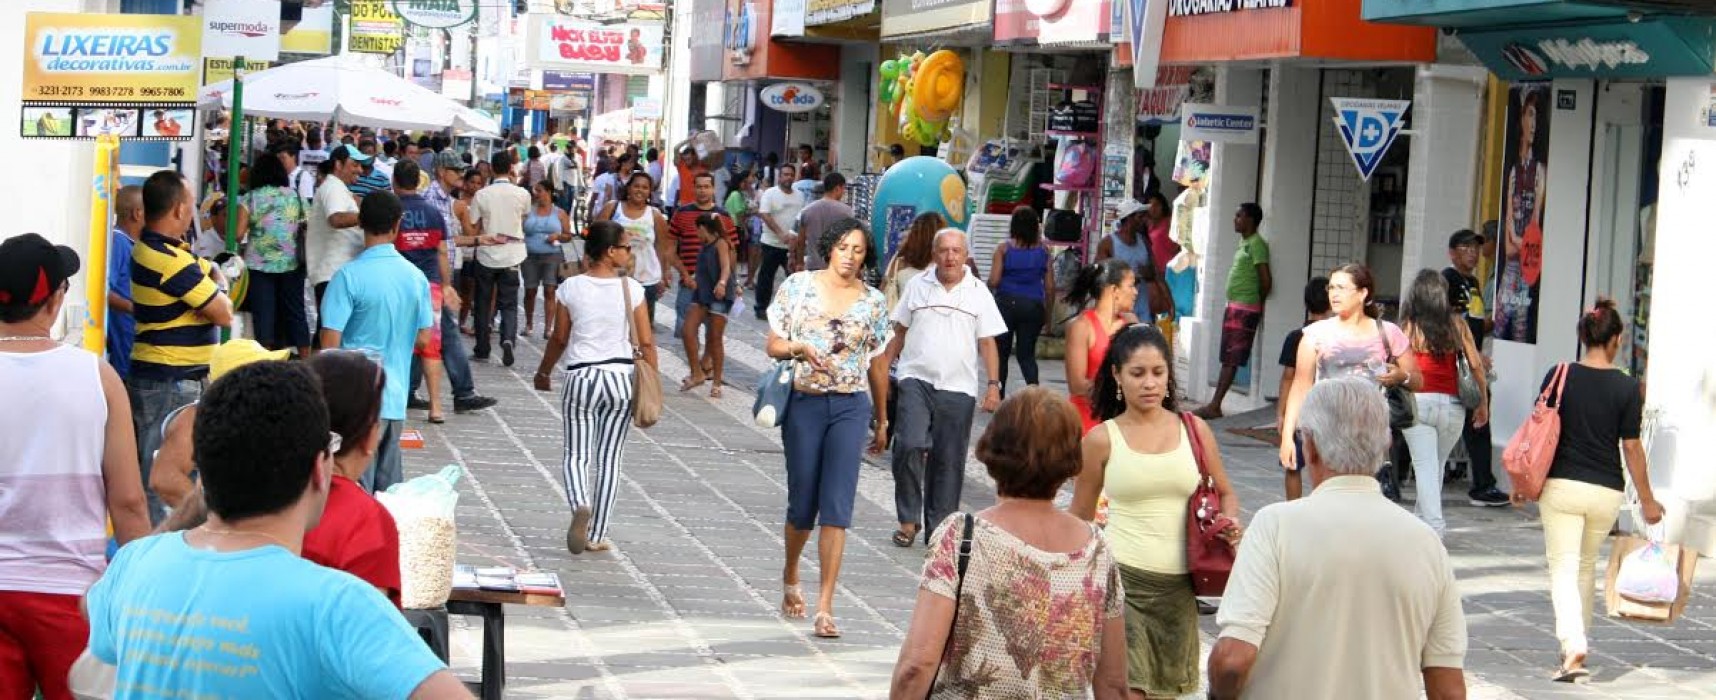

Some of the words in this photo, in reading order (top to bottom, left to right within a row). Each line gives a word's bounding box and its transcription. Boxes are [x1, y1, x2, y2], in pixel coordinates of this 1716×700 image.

[209, 21, 267, 33] supermoda
[42, 33, 171, 56] LIXEIRAS
[39, 86, 84, 96] 3231-2173
[89, 87, 134, 97] 9983-7278
[139, 87, 185, 97] 9965-7806
